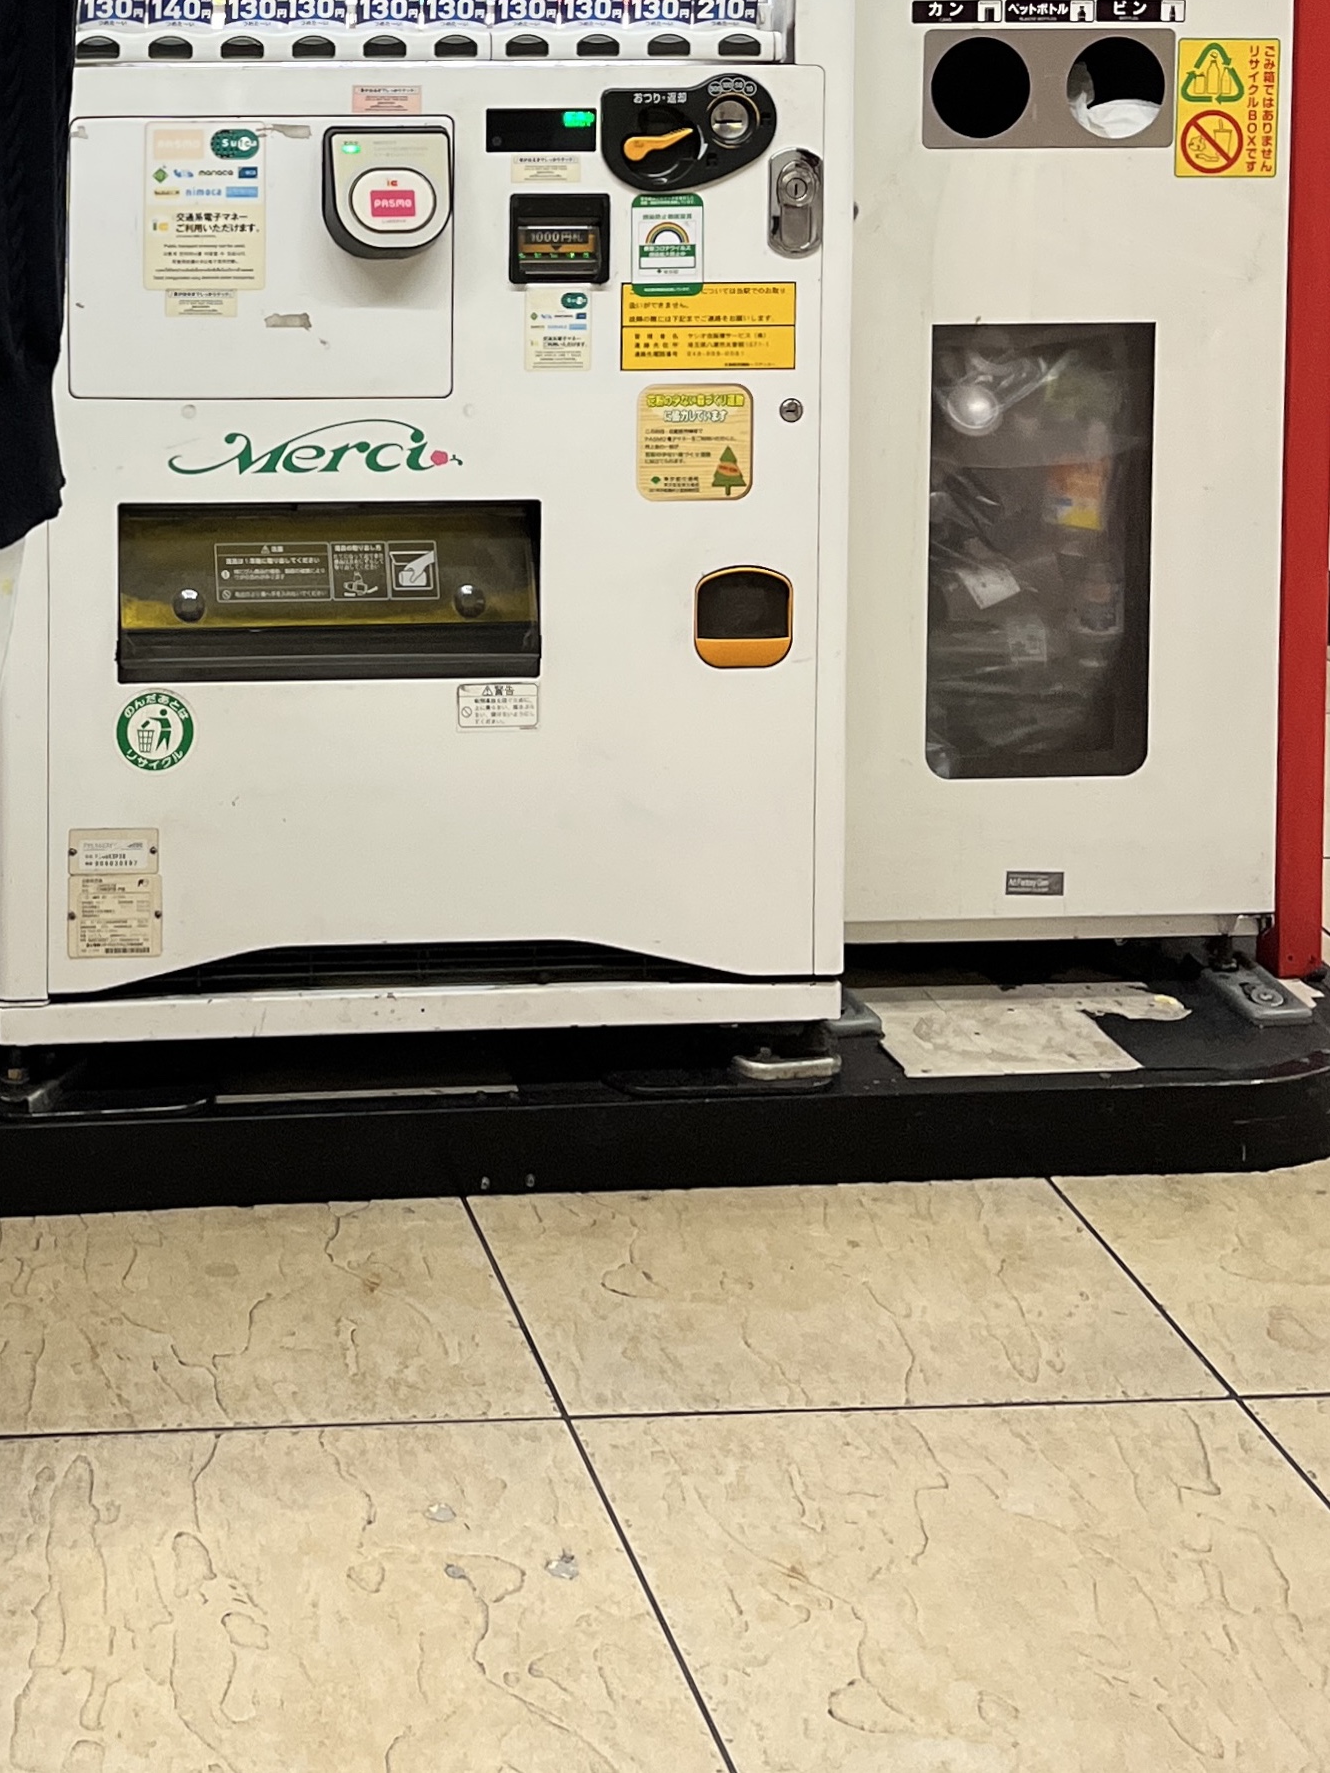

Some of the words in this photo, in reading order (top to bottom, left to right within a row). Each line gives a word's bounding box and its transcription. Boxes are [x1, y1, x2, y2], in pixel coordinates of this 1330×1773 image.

[928, 2, 965, 17] カン
[1007, 3, 1069, 16] ペットボトル
[1112, 1, 1148, 16] ビン
[633, 92, 687, 104] おつり・返却
[1246, 45, 1260, 174] リサイクルBOXです
[1262, 45, 1276, 174] ごみ箱ではありません
[221, 138, 257, 150] Suica
[186, 187, 221, 196] nimoca
[373, 198, 413, 209] PASMO
[176, 212, 248, 222] 交通系電子マネー
[176, 223, 260, 233] ご利用いただけます。
[168, 418, 435, 476] Merci
[124, 694, 188, 720] のんだあとは
[126, 749, 183, 769] リサイクル
